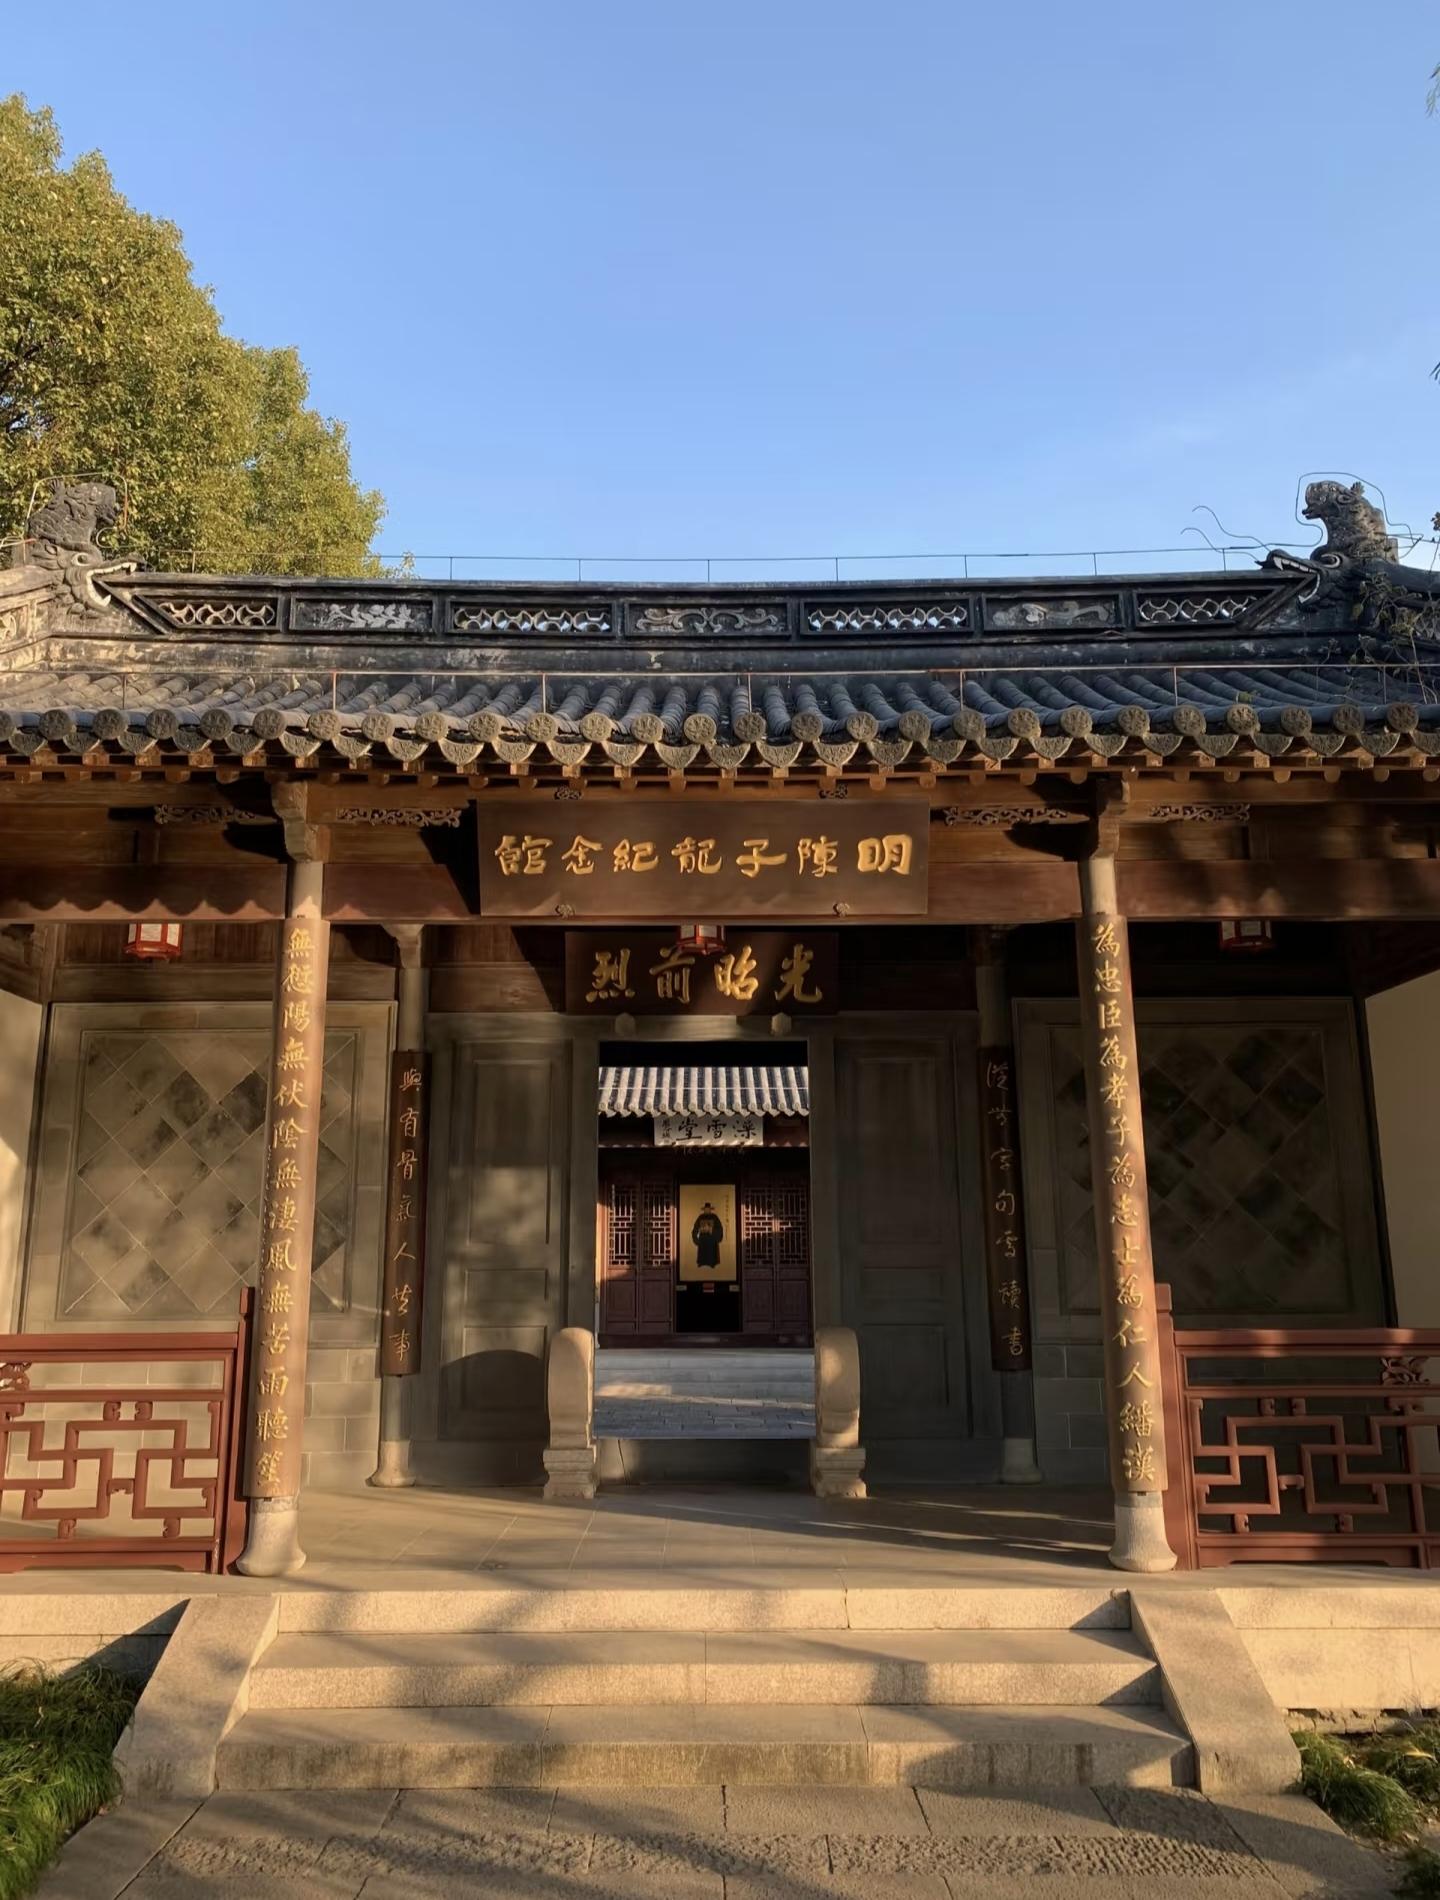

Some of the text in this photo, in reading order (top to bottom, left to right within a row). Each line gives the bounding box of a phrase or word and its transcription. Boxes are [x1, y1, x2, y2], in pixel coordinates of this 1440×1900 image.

[494, 834, 913, 877] 明陳子龍紀念館
[585, 943, 823, 1003] 光昭前烈
